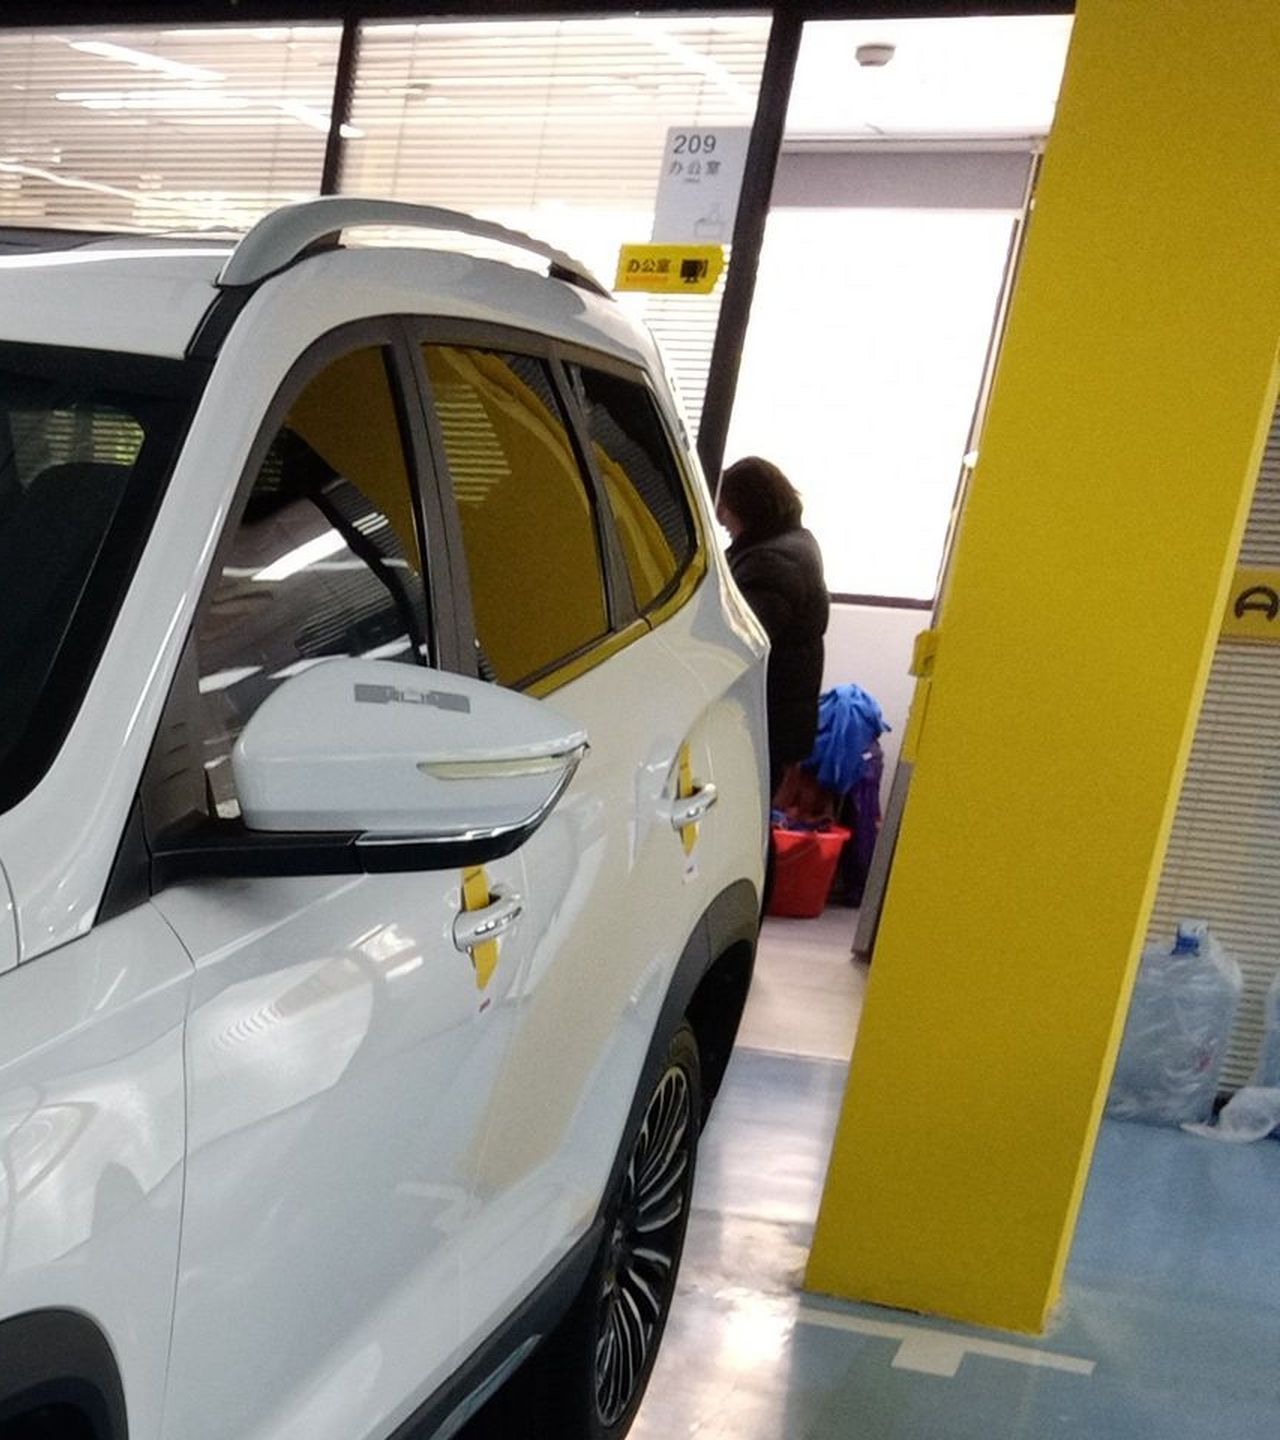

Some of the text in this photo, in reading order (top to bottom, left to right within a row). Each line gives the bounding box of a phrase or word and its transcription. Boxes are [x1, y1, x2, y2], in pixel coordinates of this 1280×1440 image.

[673, 134, 716, 154] 209
[668, 160, 721, 175] 办公室
[627, 258, 672, 274] 办公室
